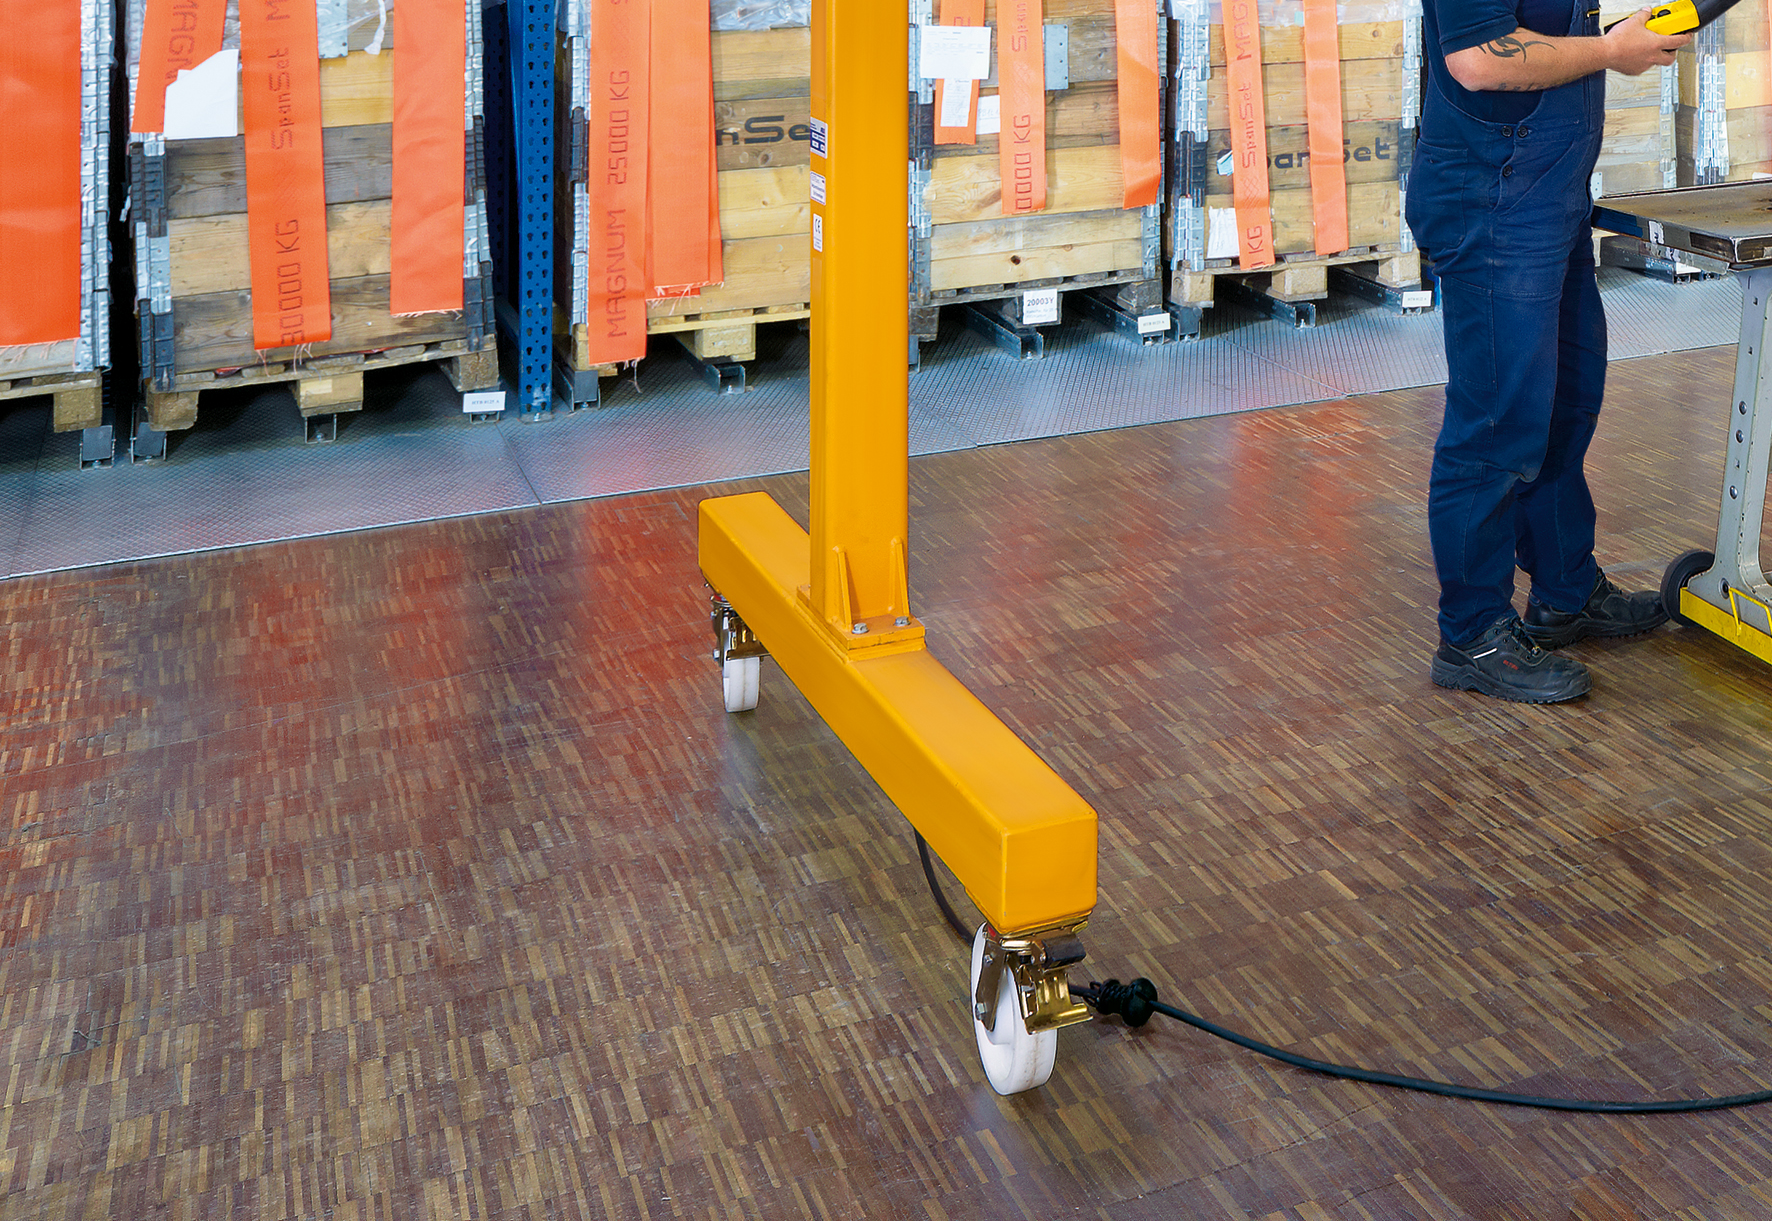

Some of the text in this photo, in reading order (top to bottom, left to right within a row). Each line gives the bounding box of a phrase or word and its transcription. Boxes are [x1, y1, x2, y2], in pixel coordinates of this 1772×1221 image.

[267, 47, 295, 151] SpanSet
[1013, 114, 1031, 144] KG
[1237, 82, 1257, 169] SpanSet
[606, 70, 630, 338] MAGNUM 25000 KG
[1246, 225, 1264, 254] KG
[275, 218, 305, 345] 30000 KG
